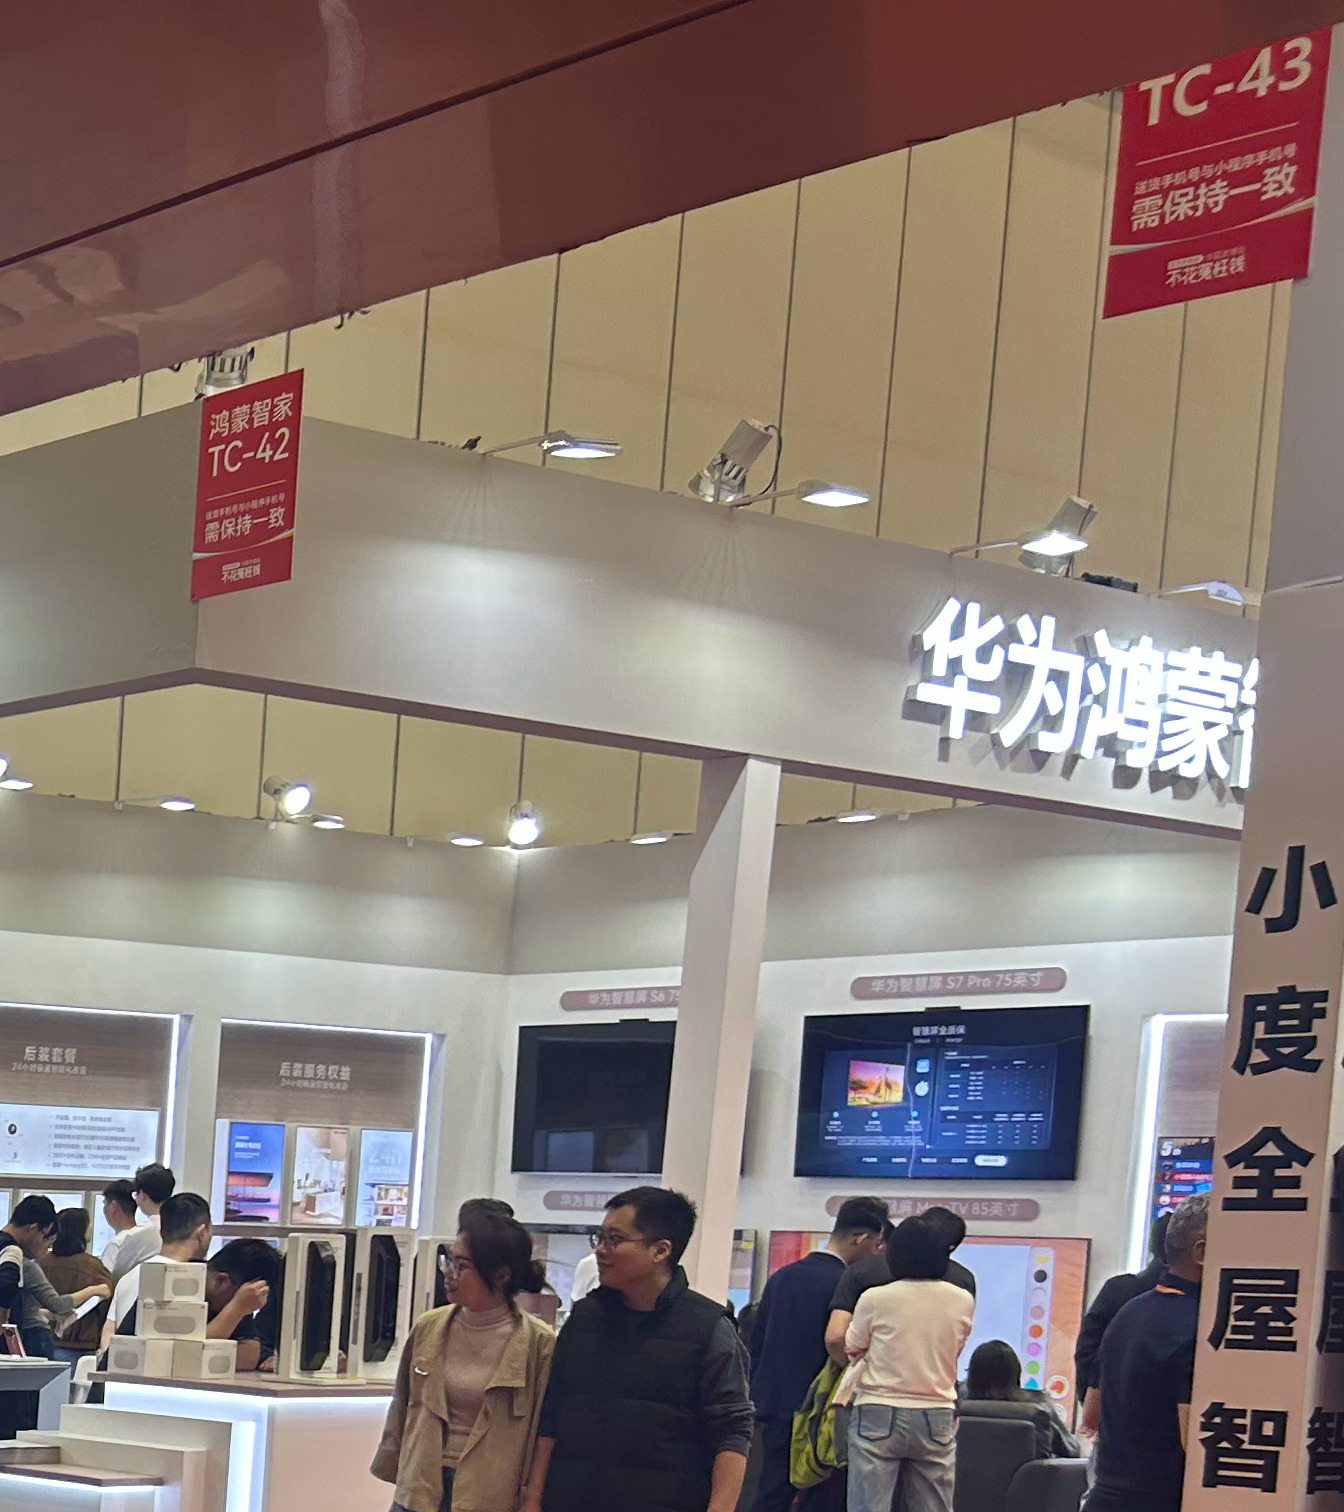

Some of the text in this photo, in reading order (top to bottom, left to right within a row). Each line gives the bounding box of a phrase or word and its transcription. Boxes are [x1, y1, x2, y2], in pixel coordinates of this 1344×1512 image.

[1139, 36, 1313, 127] TC-43
[1130, 162, 1299, 232] 需保持一致
[208, 392, 295, 441] 鸿蒙智家
[207, 427, 290, 478] TC-42
[204, 507, 286, 544] 需保持一致
[915, 597, 1262, 790] 华为鸿蒙
[668, 988, 680, 1002] 75
[946, 975, 963, 990] S7
[967, 974, 992, 989] Pro
[995, 971, 1044, 988] 75英寸
[971, 1201, 1020, 1217] 85英寸
